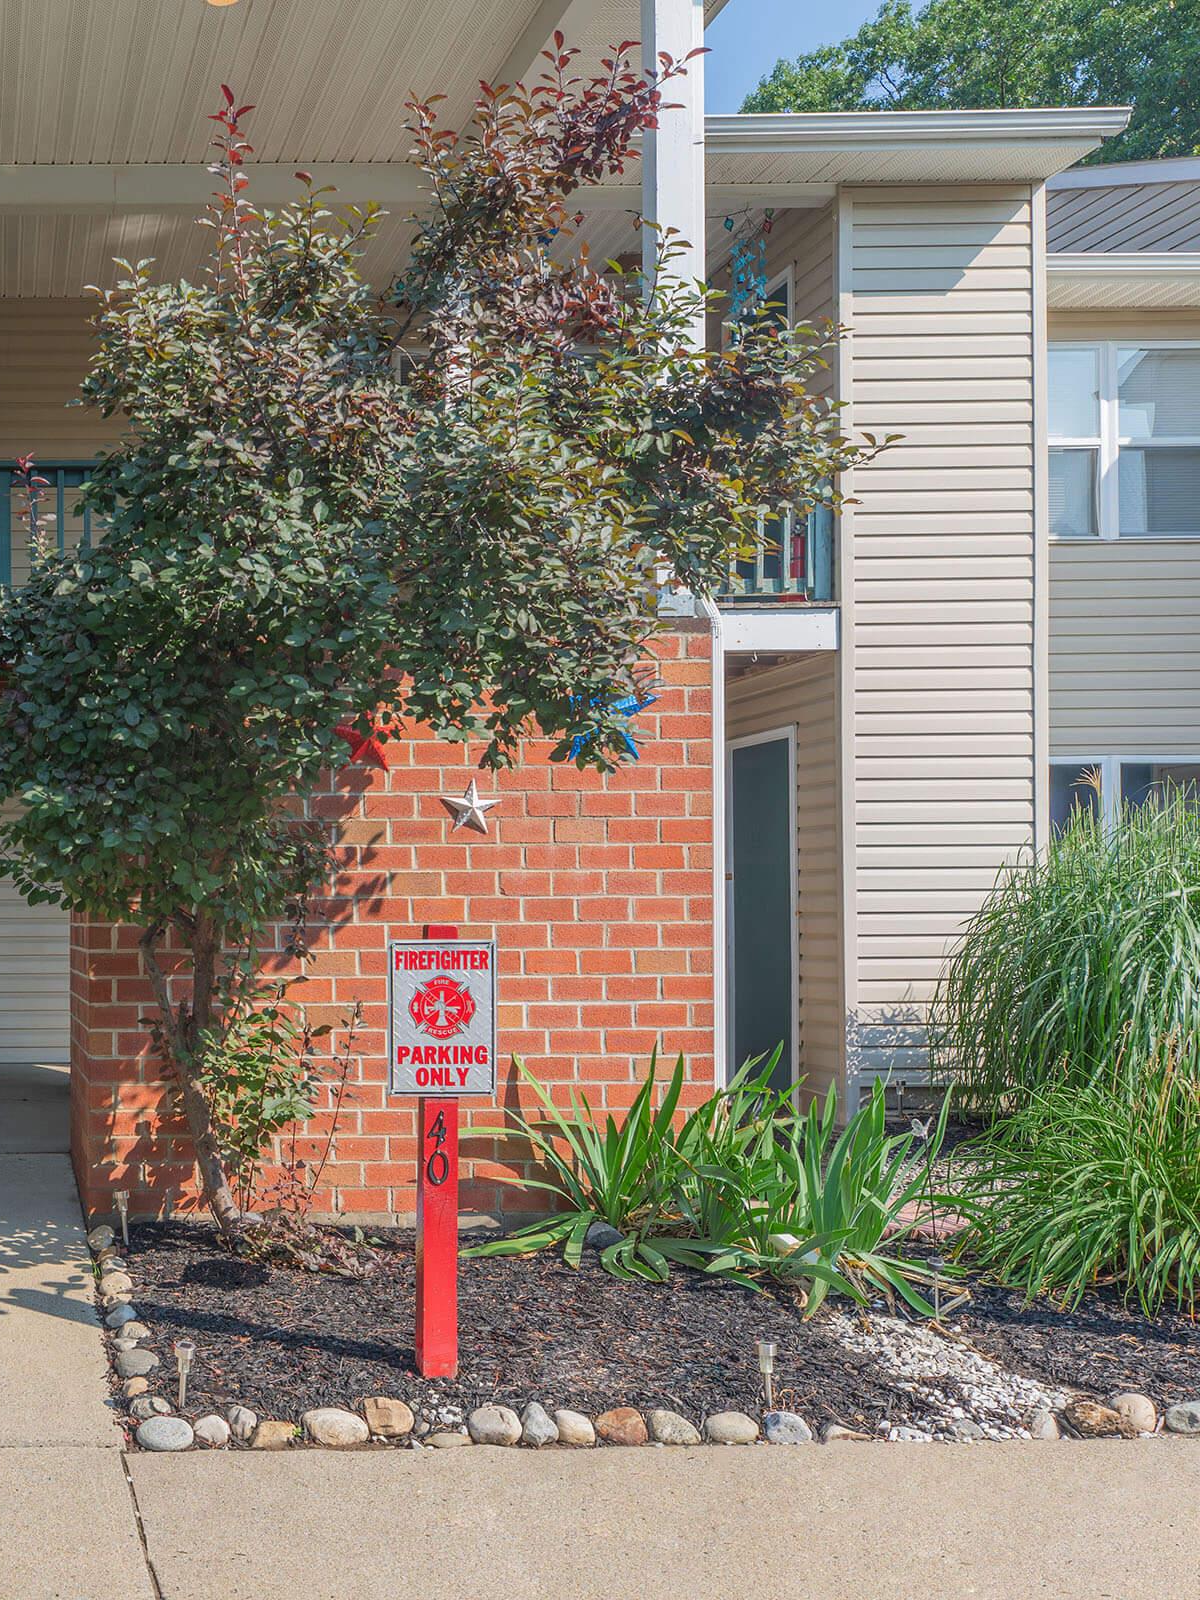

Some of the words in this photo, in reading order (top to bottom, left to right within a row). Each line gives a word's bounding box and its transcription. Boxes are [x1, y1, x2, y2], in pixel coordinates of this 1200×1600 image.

[395, 950, 489, 970] FIREFIGHTER
[427, 1027, 458, 1036] RESCUE
[397, 1045, 488, 1065] PARKING
[415, 1067, 469, 1087] ONLY
